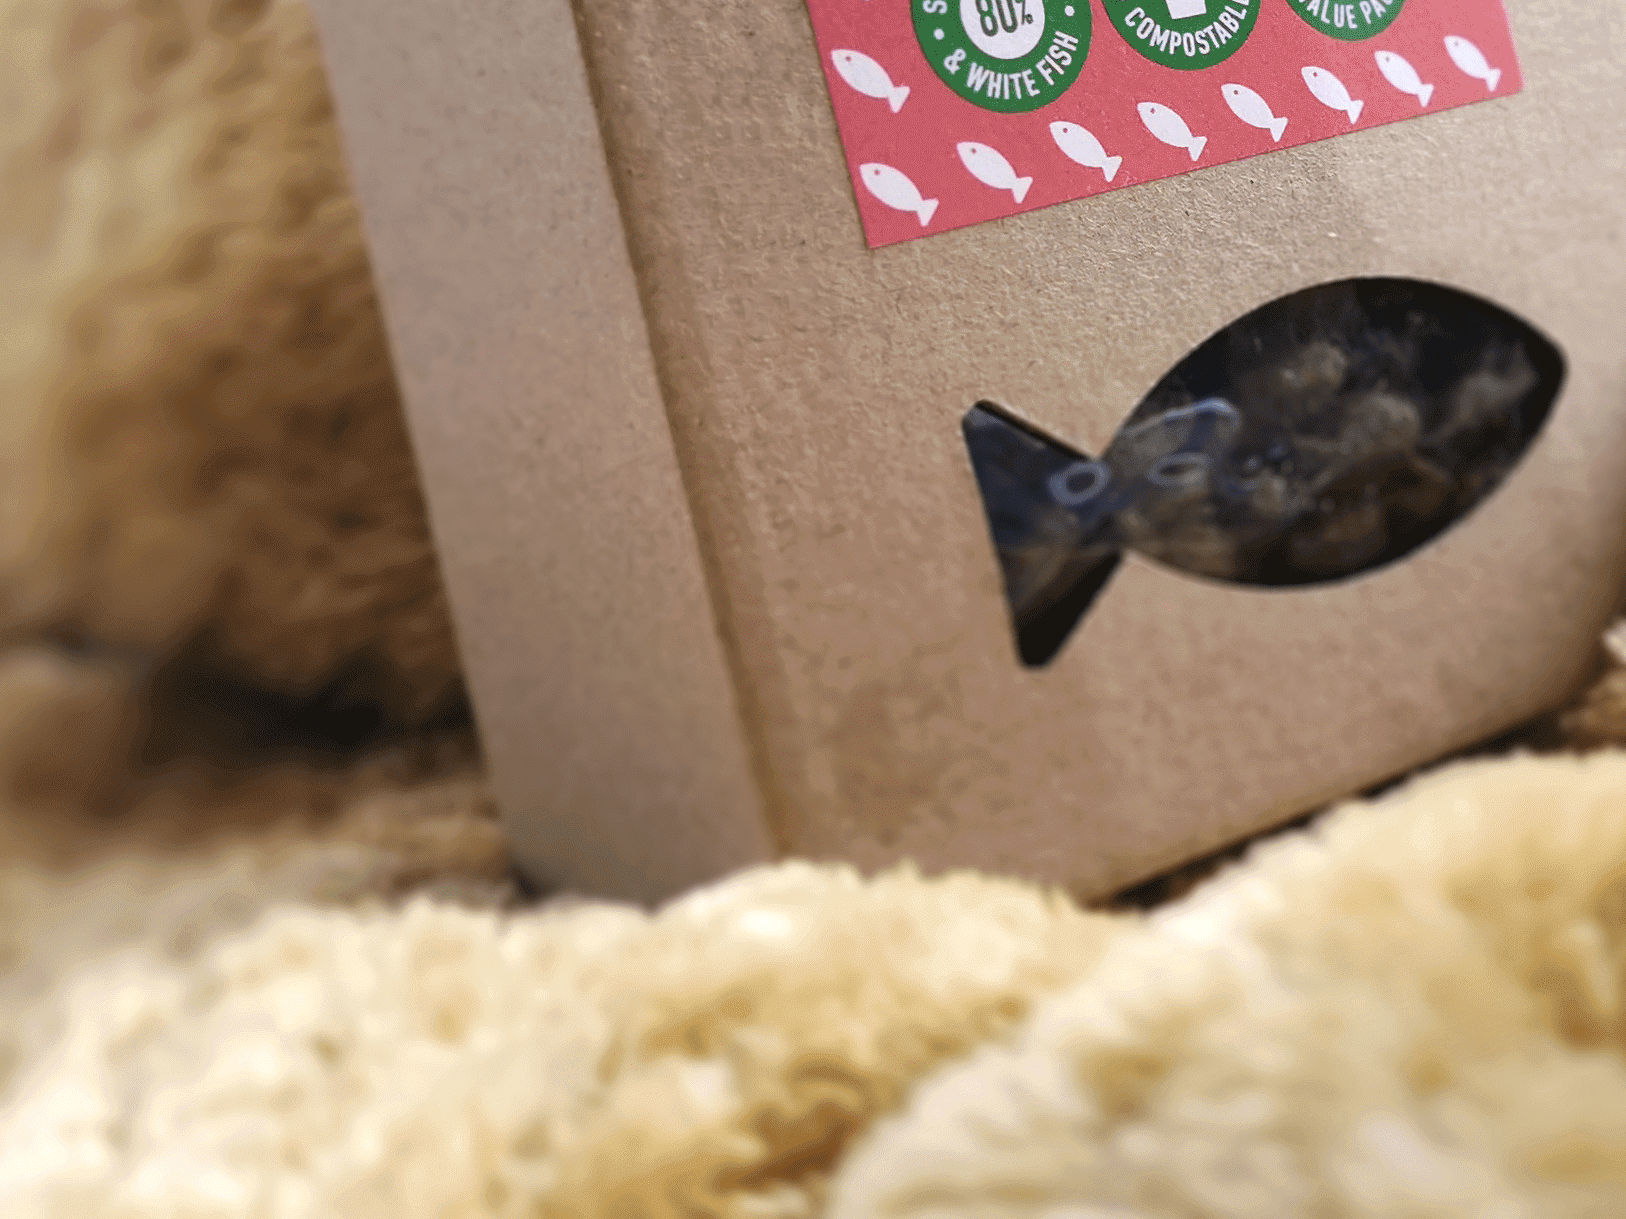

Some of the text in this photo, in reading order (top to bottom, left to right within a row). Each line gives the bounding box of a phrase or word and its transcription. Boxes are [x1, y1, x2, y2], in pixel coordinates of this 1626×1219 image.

[943, 30, 1080, 100] & WHITE FISH
